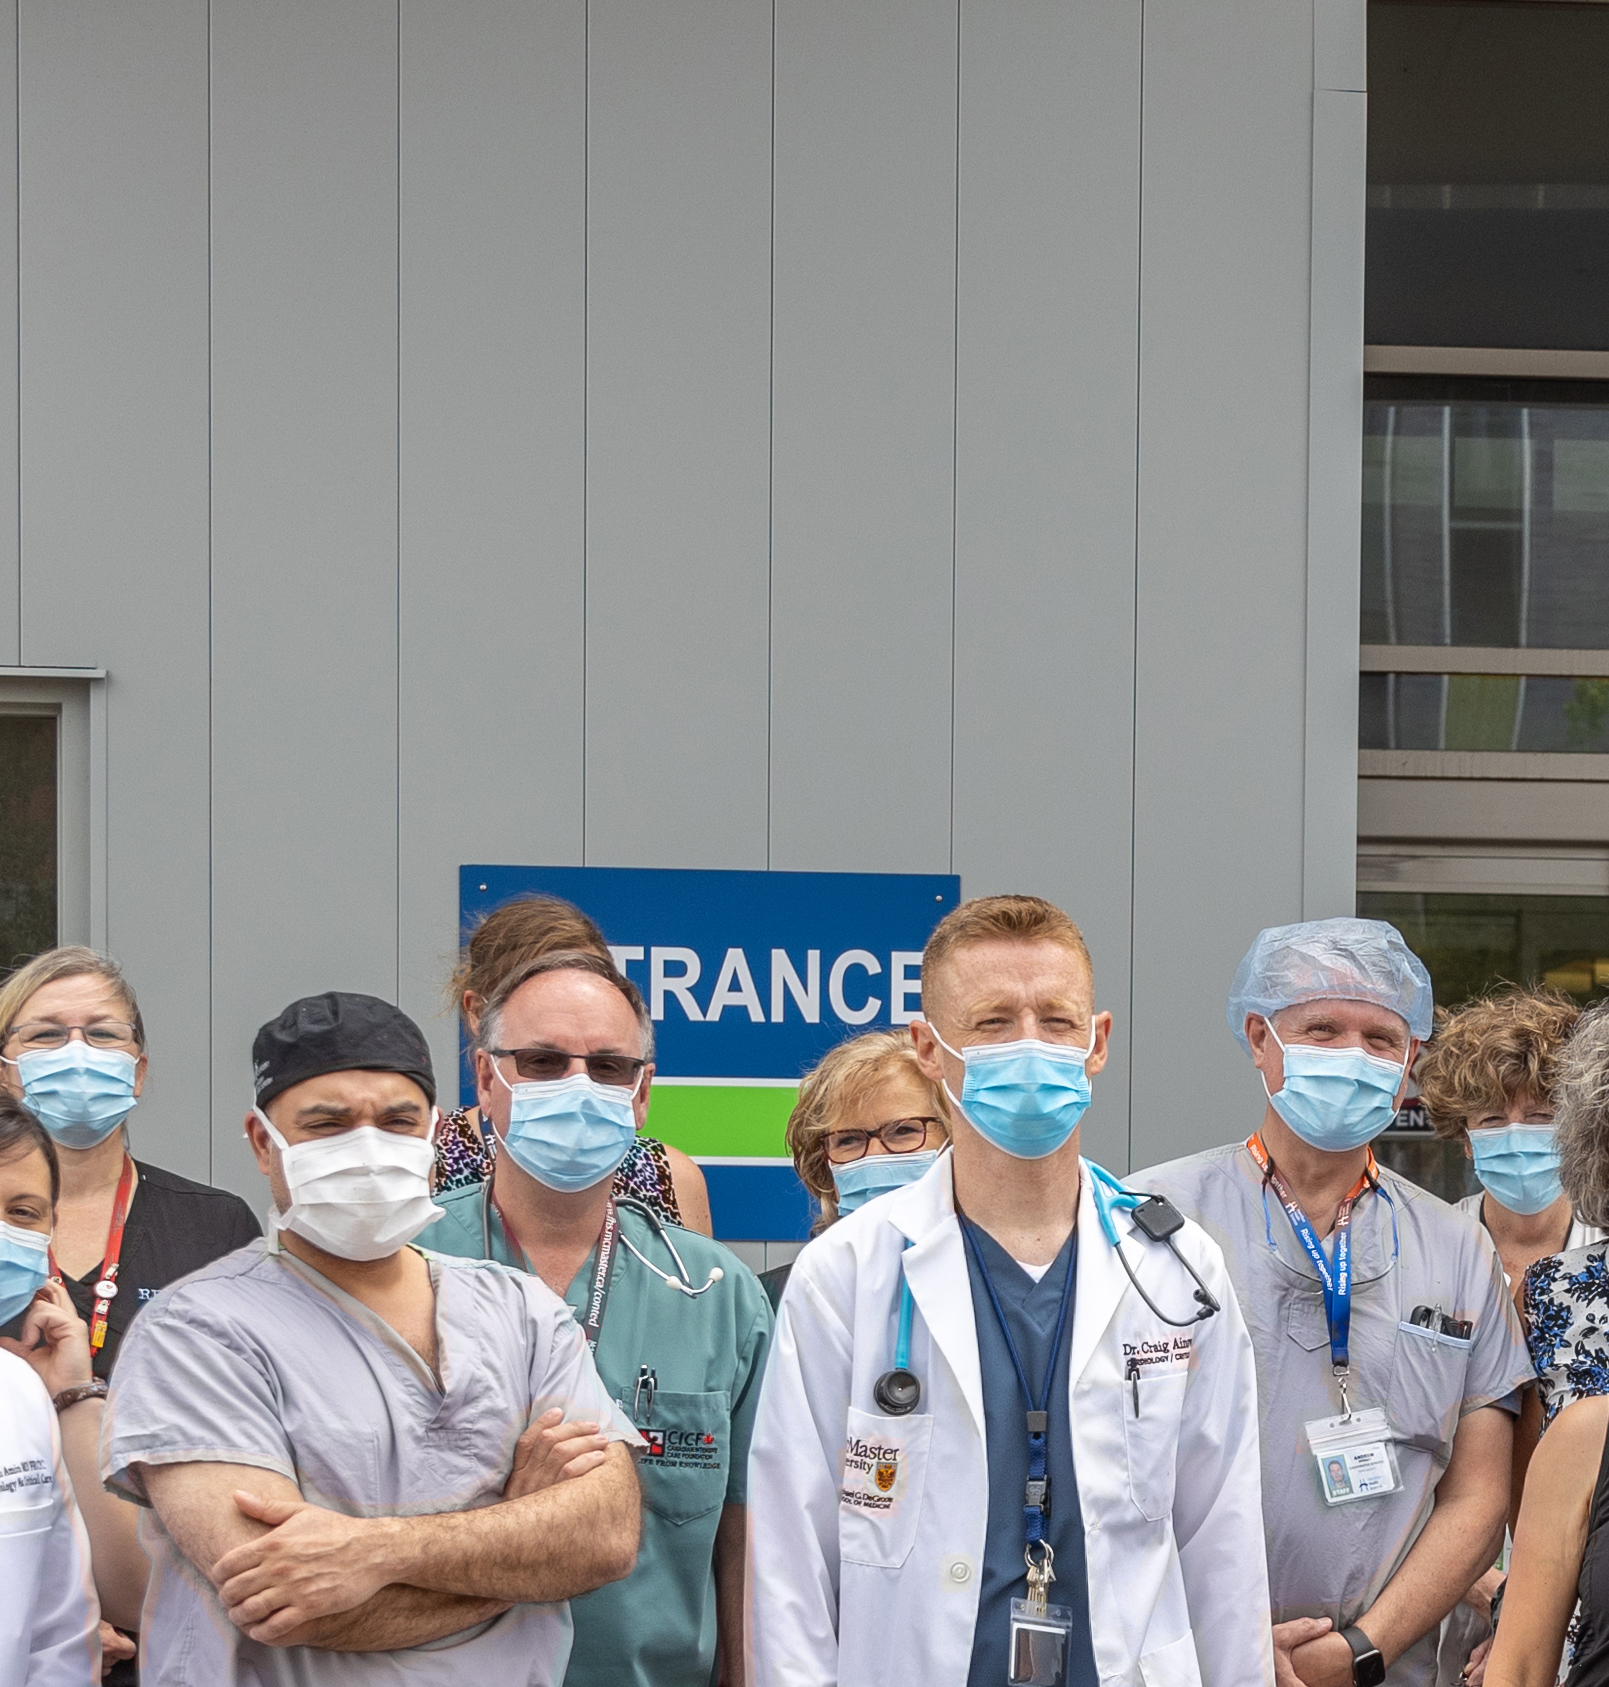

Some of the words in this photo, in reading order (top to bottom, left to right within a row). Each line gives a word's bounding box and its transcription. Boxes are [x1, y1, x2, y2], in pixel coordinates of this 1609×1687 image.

[1249, 1143, 1264, 1164] Rising
[1339, 1231, 1348, 1260] together
[1300, 1228, 1314, 1250] Rising
[1311, 1249, 1319, 1260] up
[1316, 1259, 1333, 1292] together
[1339, 1261, 1348, 1272] up
[1338, 1272, 1348, 1296] Rising
[1122, 1343, 1140, 1355] Dr.
[1141, 1341, 1170, 1354] Craig
[668, 1430, 704, 1446] CICF
[846, 1436, 900, 1461] Master
[1332, 1487, 1351, 1497] STAFF
